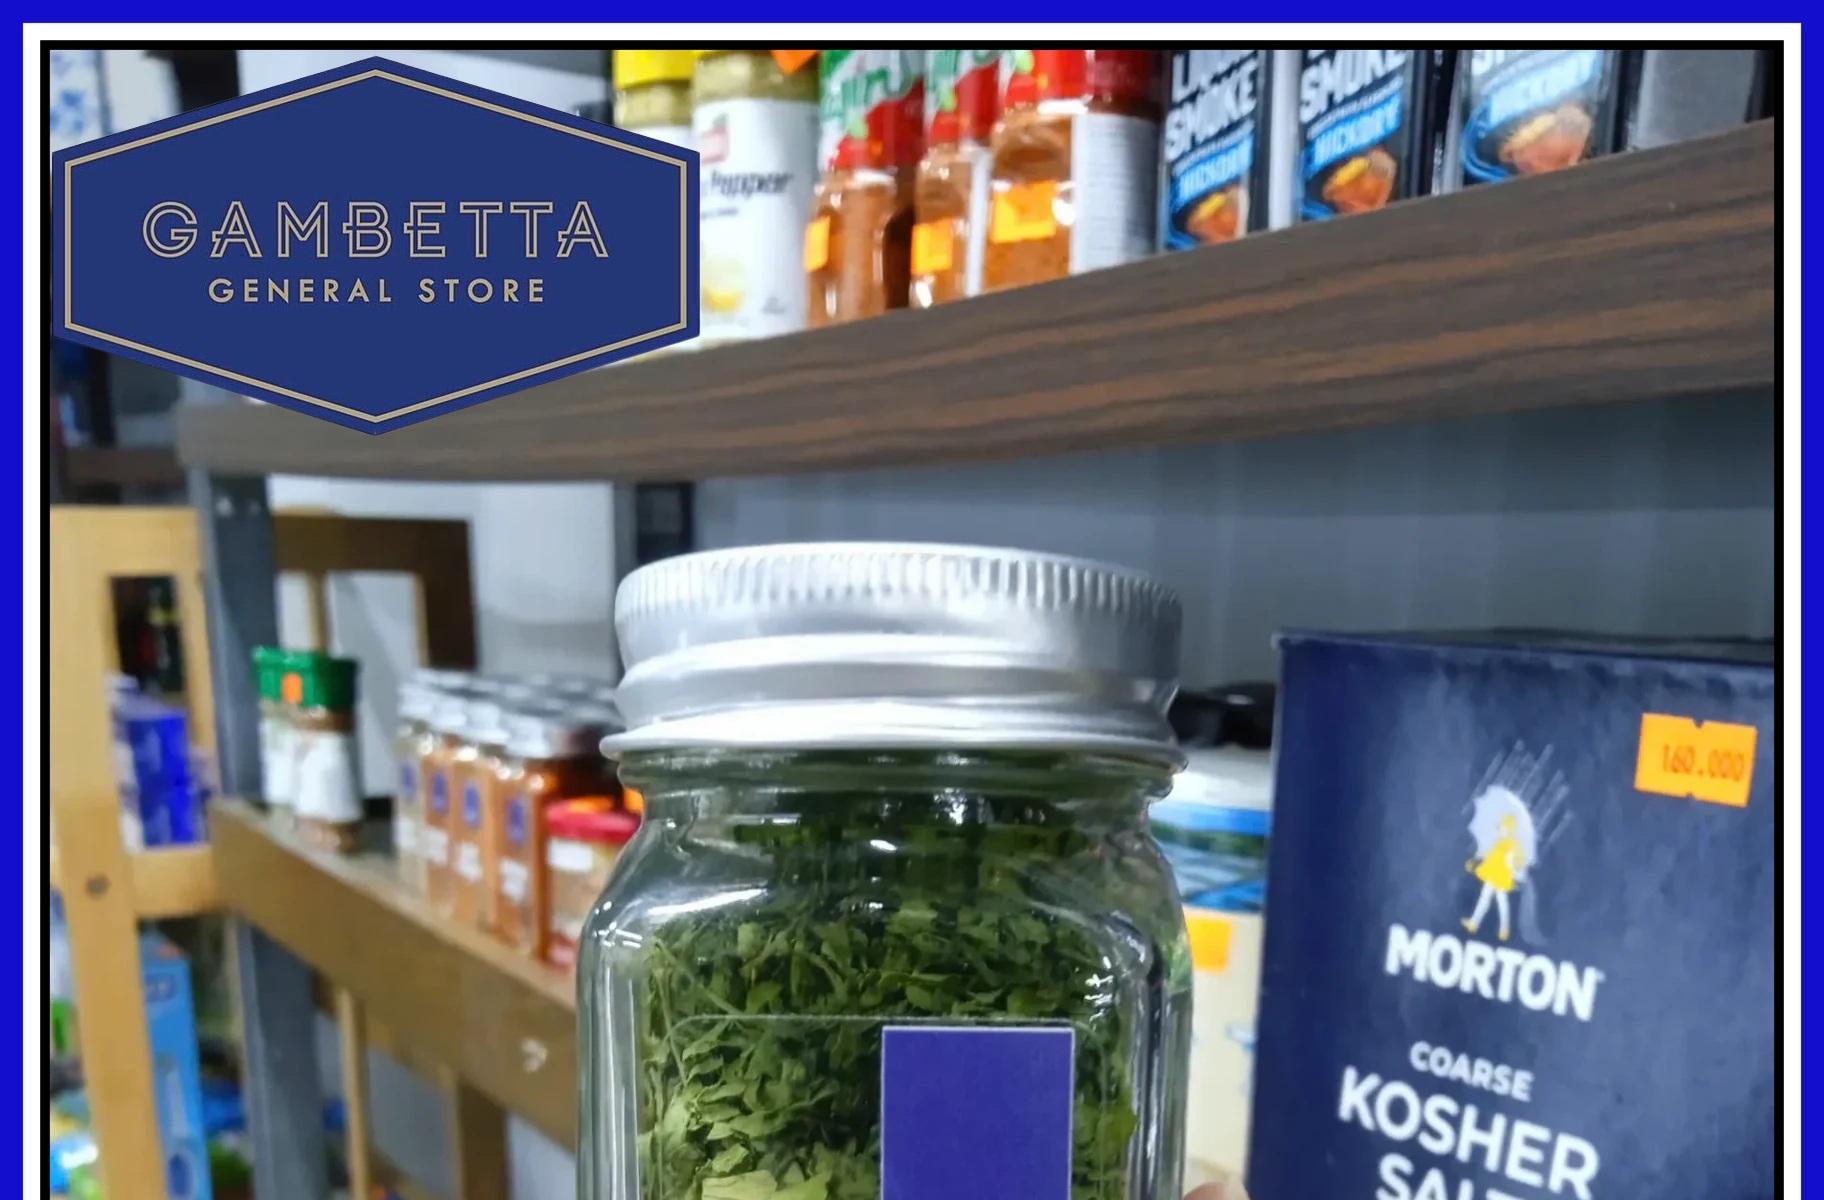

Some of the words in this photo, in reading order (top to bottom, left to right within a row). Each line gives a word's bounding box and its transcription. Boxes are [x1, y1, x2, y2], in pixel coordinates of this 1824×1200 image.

[1165, 58, 1257, 163] SMOKE
[711, 169, 794, 200] Pepper
[1662, 743, 1745, 782] 160.000
[1385, 923, 1599, 1021] MORTON
[1410, 1041, 1535, 1102] COARSE
